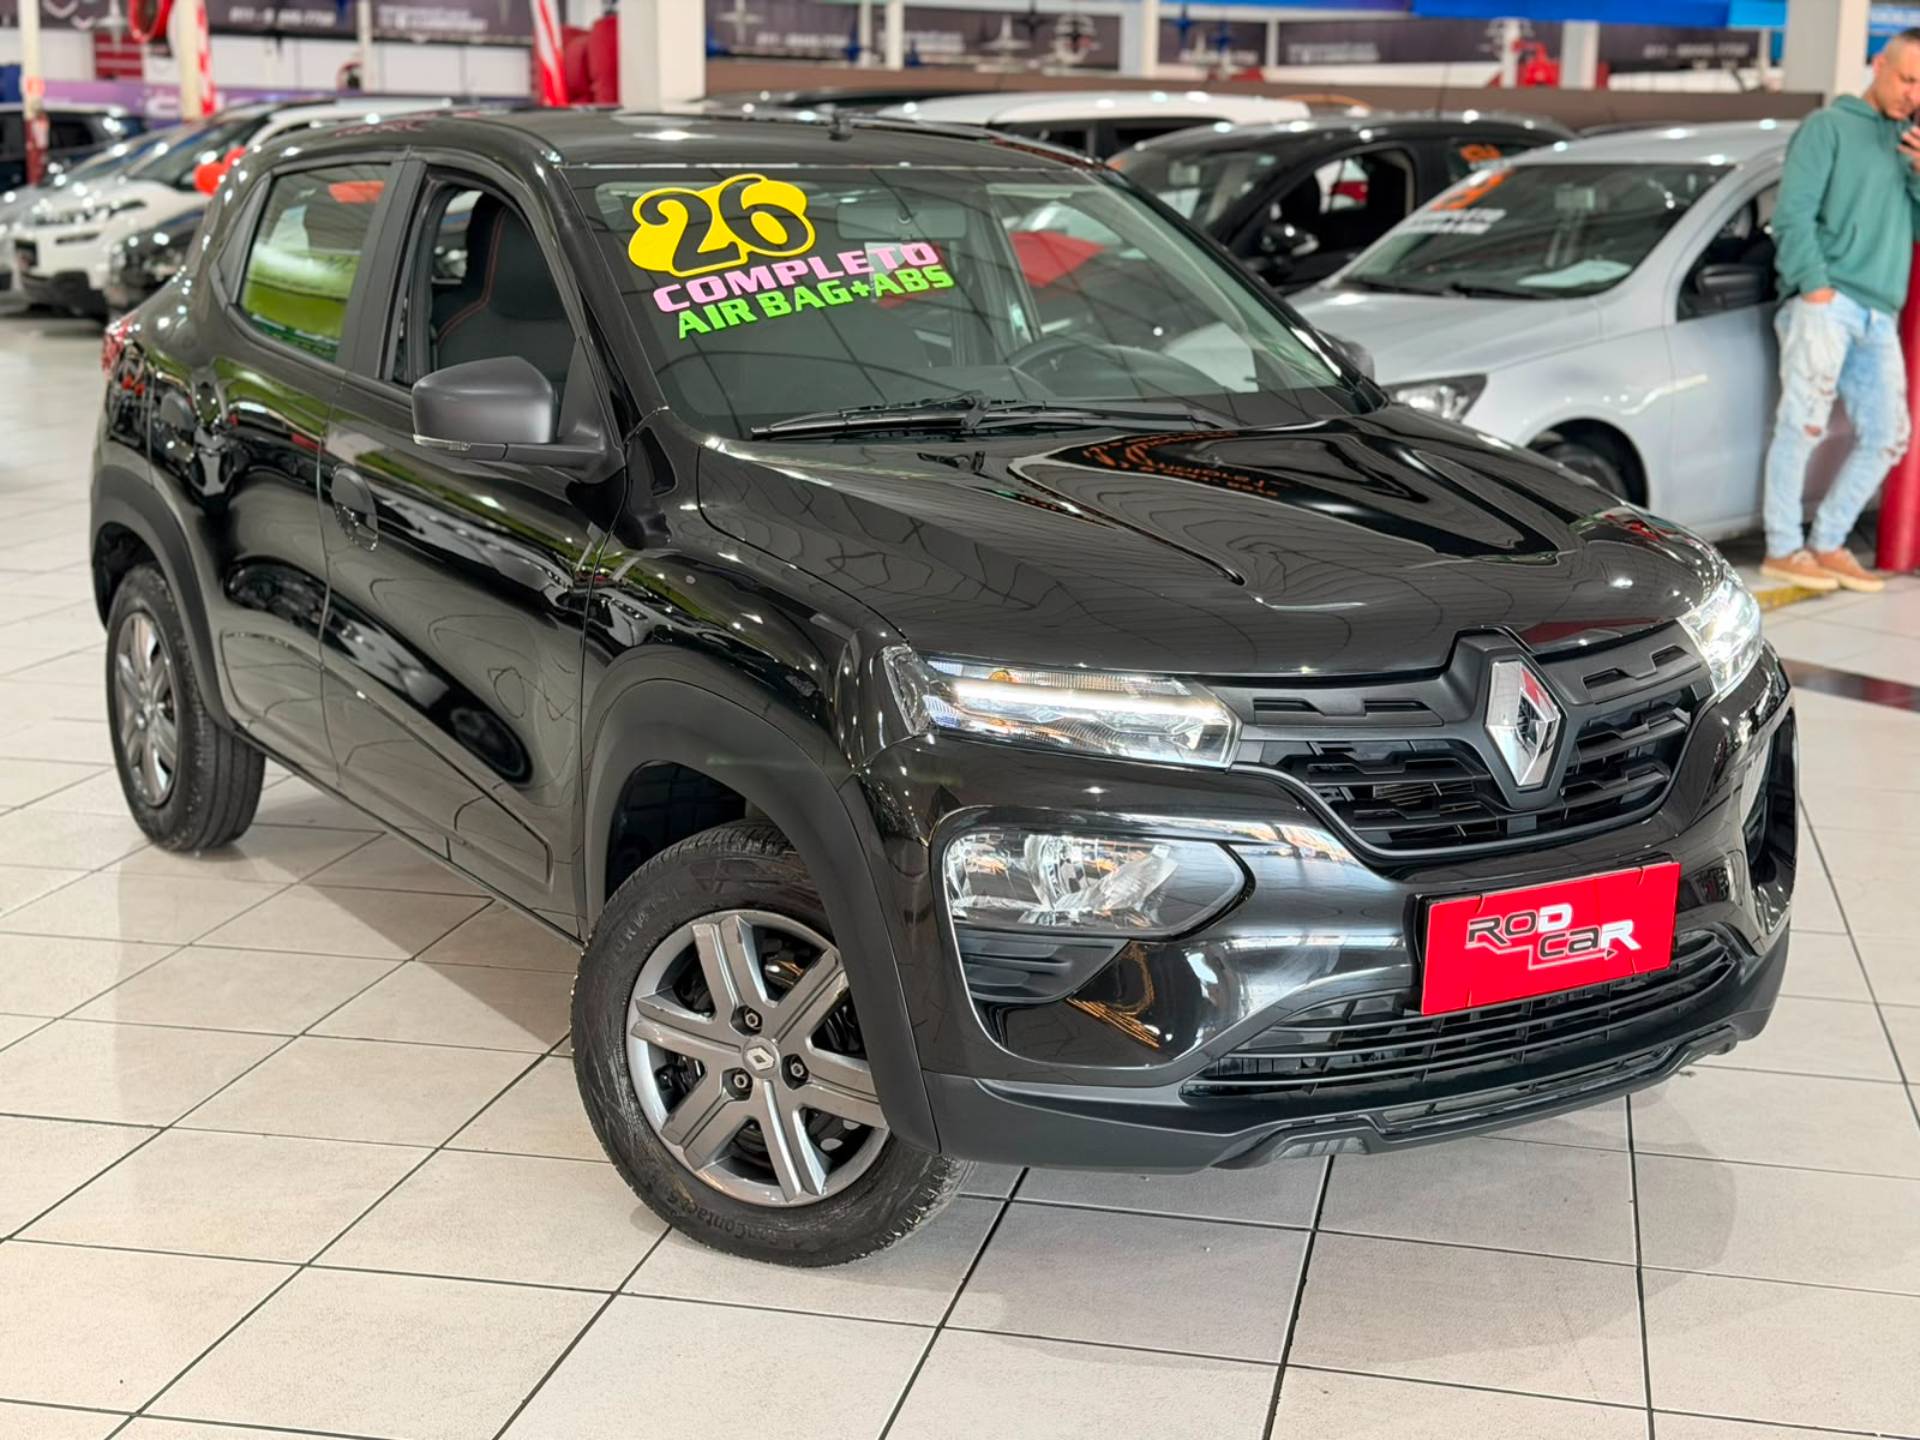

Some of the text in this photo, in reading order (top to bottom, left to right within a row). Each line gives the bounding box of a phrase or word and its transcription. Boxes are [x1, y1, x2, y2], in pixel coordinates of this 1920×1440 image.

[630, 174, 815, 277] 26
[652, 242, 939, 313] COMPLETO
[678, 298, 758, 340] AIR
